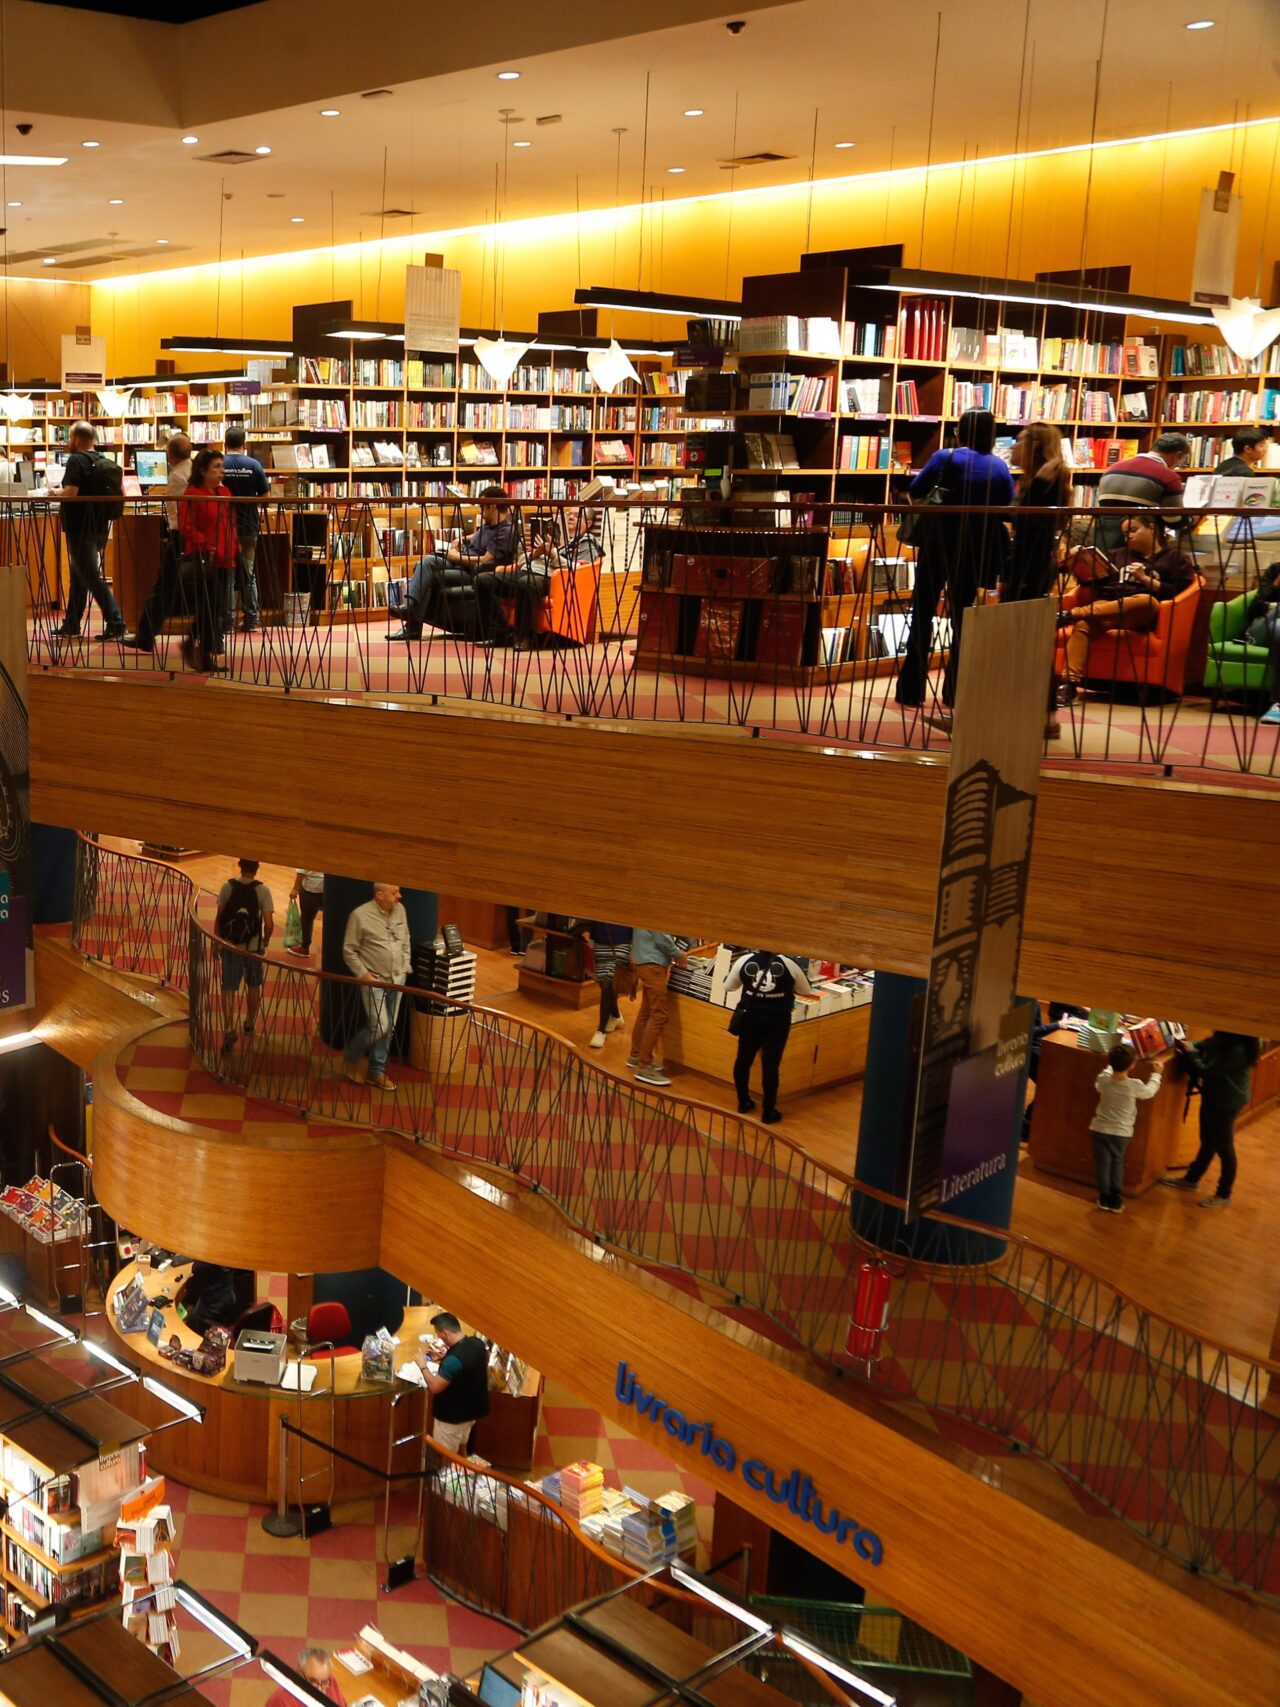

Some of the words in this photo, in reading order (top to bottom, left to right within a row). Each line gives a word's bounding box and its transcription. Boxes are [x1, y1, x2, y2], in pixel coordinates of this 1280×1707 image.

[997, 1032, 1029, 1057] livraria
[995, 1052, 1027, 1077] cultura
[940, 1153, 1007, 1204] Literatura
[615, 1360, 736, 1473] livraria
[741, 1460, 884, 1567] cultura
